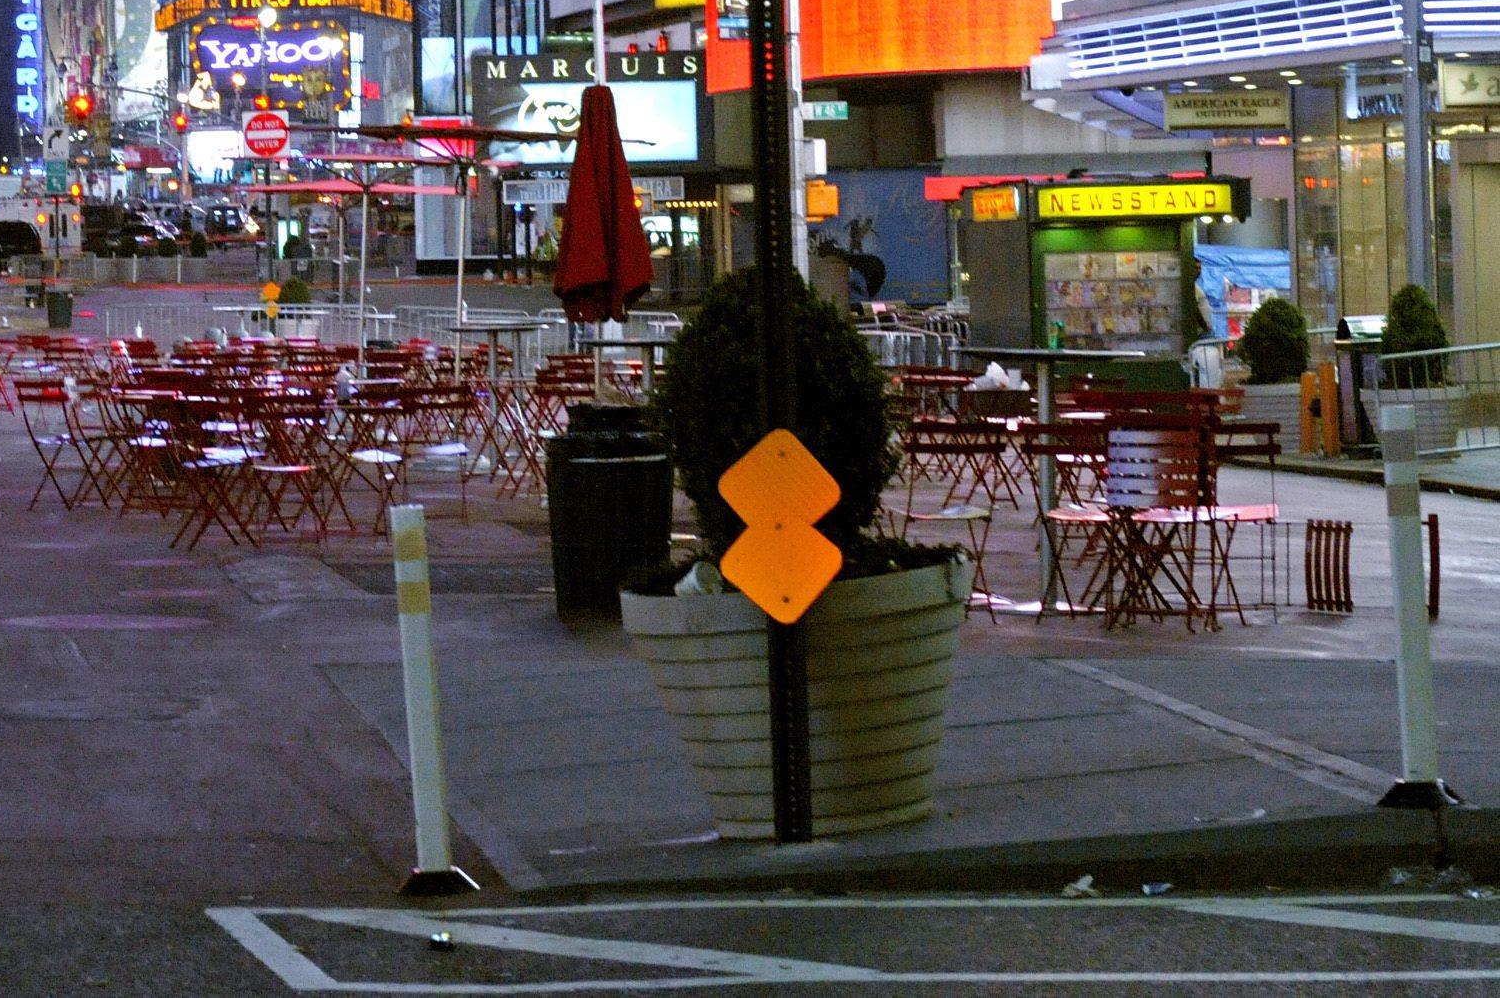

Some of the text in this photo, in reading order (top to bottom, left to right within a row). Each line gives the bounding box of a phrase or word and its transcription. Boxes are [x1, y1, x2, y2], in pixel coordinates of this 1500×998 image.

[1172, 96, 1281, 110] AMERICAN EAGLE
[1195, 108, 1259, 119] OUTFITTERS
[251, 119, 280, 129] DO NOT
[254, 139, 280, 149] ENTER
[1049, 188, 1218, 212] NEWSSTAND
